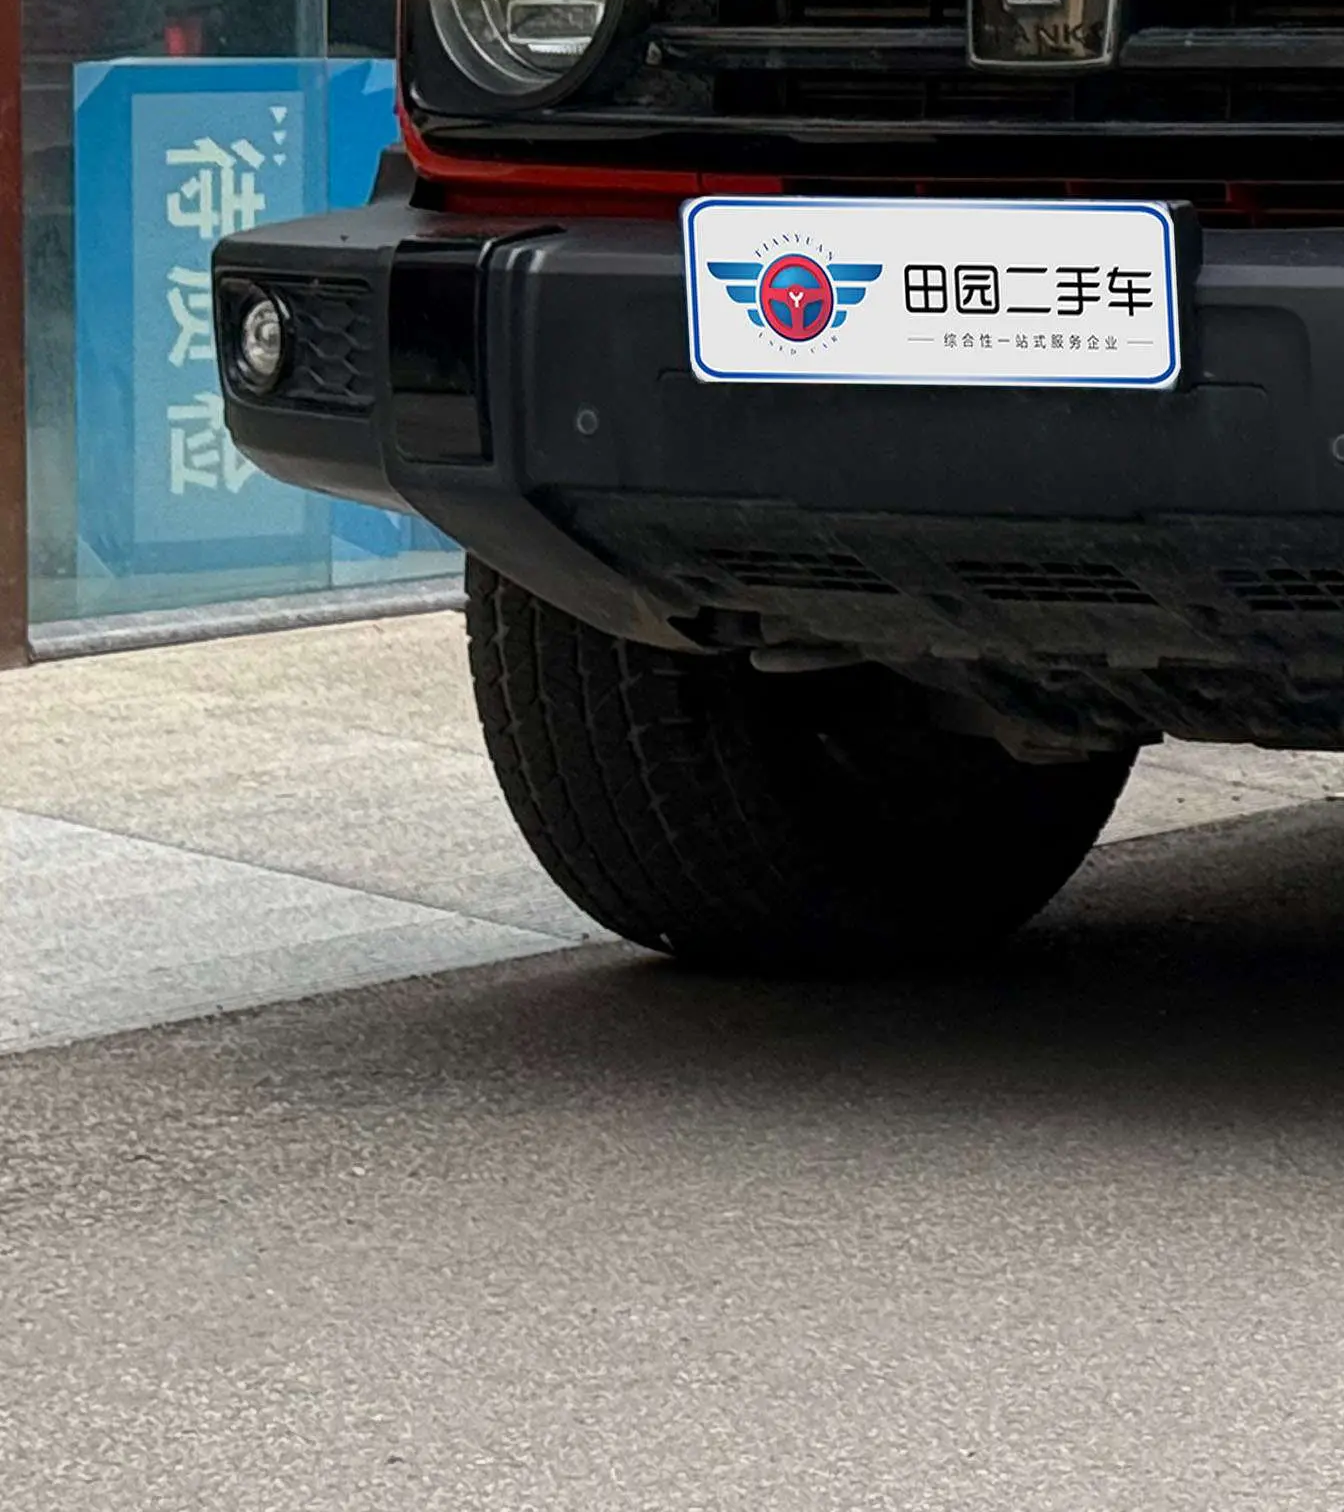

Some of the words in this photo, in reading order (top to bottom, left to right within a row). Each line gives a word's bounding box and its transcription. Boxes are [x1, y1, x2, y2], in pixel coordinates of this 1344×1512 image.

[904, 264, 1154, 318] 田园二手车
[943, 333, 1118, 351] 综合性一站式服务企业
